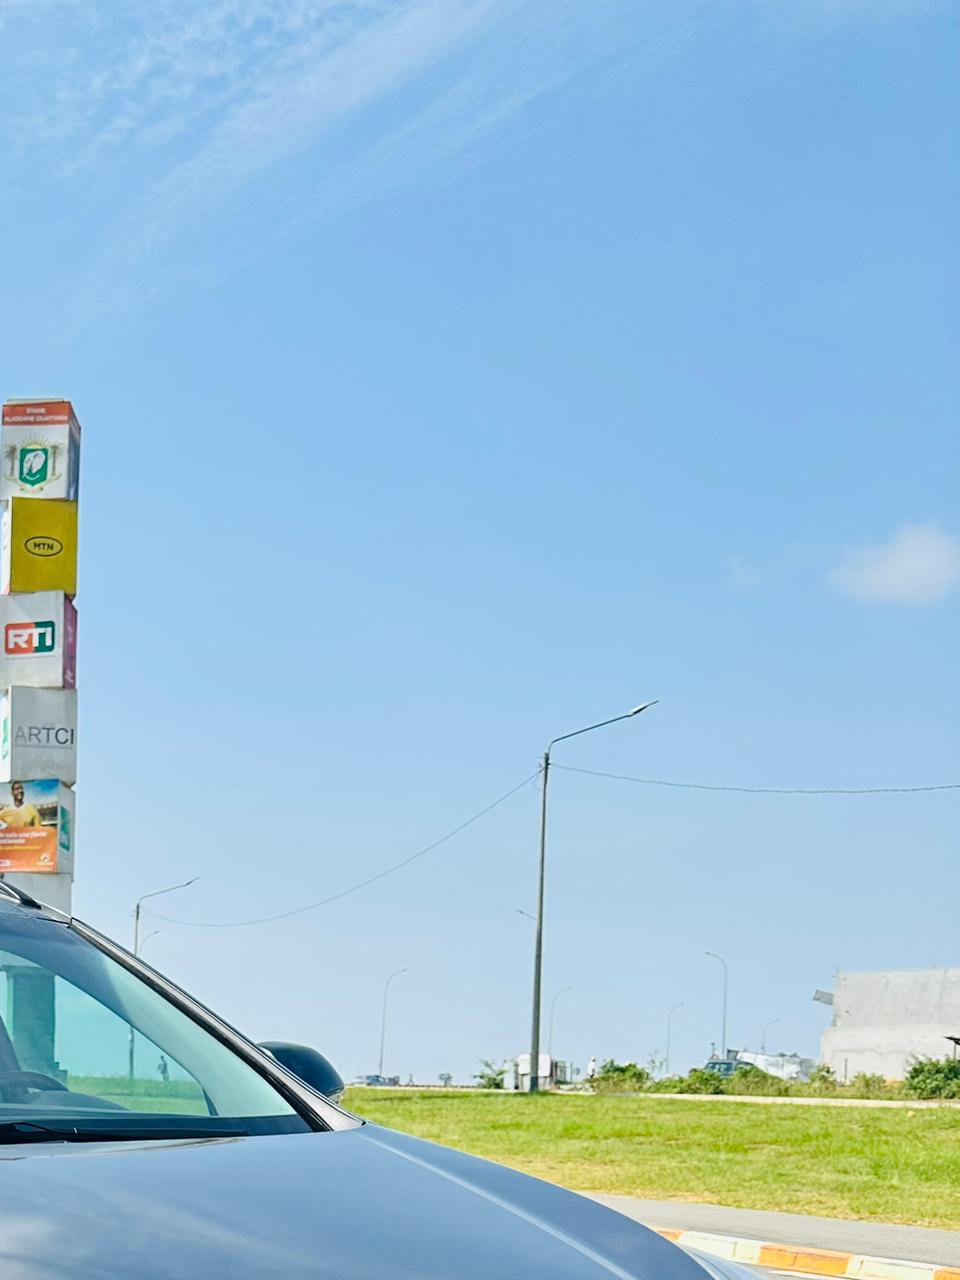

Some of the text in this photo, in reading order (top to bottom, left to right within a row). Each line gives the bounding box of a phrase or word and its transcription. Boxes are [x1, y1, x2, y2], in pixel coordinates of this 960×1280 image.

[33, 542, 54, 551] MTN
[7, 627, 53, 649] RTI
[14, 726, 74, 745] ARTCI
